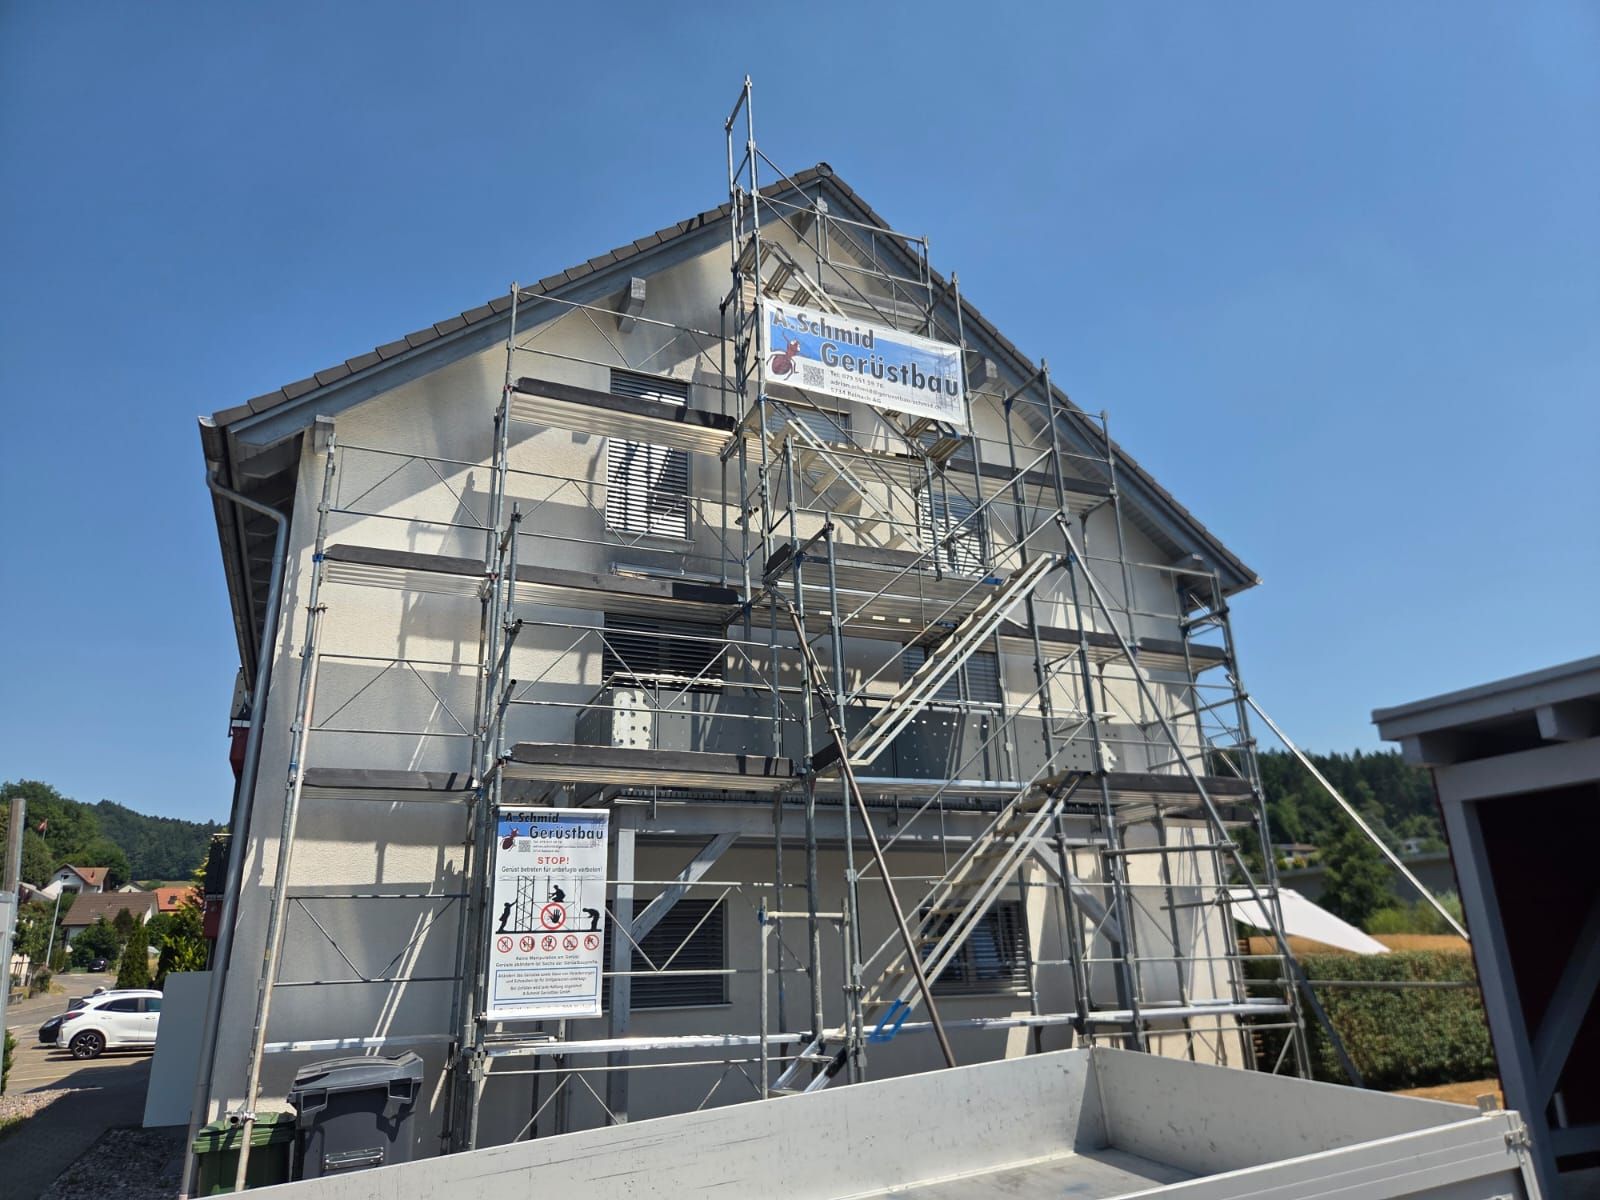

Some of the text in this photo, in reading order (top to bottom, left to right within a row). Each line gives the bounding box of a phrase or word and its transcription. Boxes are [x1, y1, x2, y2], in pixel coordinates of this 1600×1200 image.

[820, 342, 959, 396] Gerüstbau
[505, 812, 560, 823] ASchmid
[529, 825, 604, 840] Gerüstbau
[537, 856, 570, 865] STOP!
[501, 865, 520, 873] Gerüst
